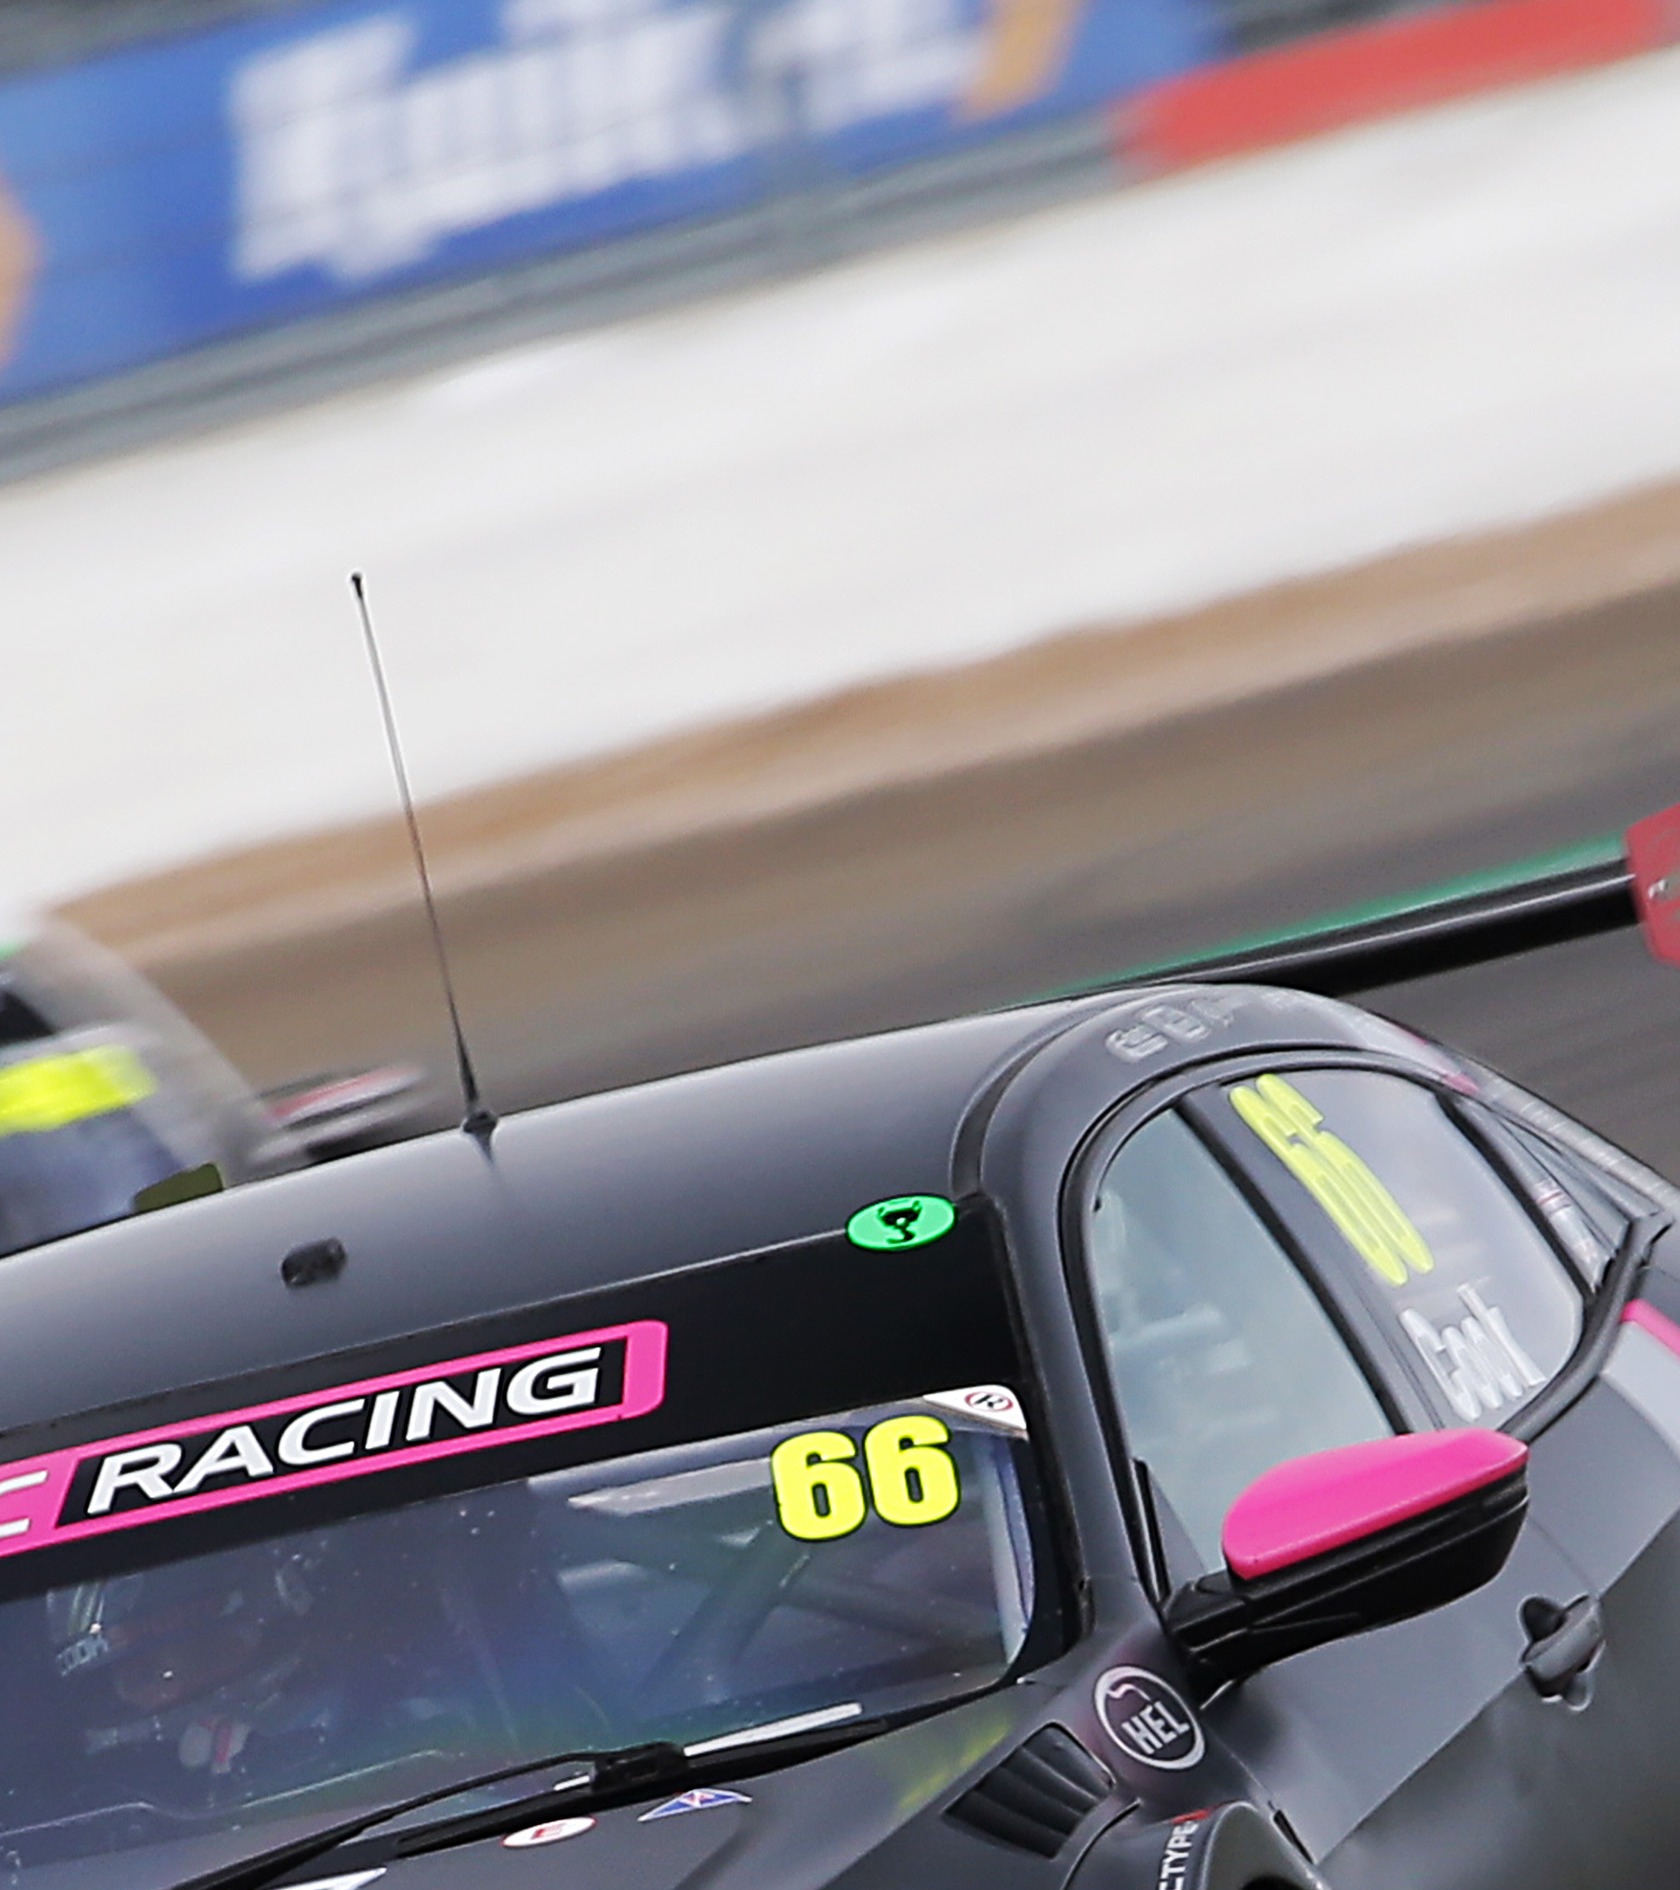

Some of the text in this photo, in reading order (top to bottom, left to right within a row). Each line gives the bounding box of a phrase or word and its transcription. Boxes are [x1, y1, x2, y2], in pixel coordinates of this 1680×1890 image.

[1229, 1073, 1433, 1286] 66
[86, 1345, 601, 1516] RACING
[770, 1413, 961, 1542] 66
[1121, 1701, 1190, 1757] HEL
